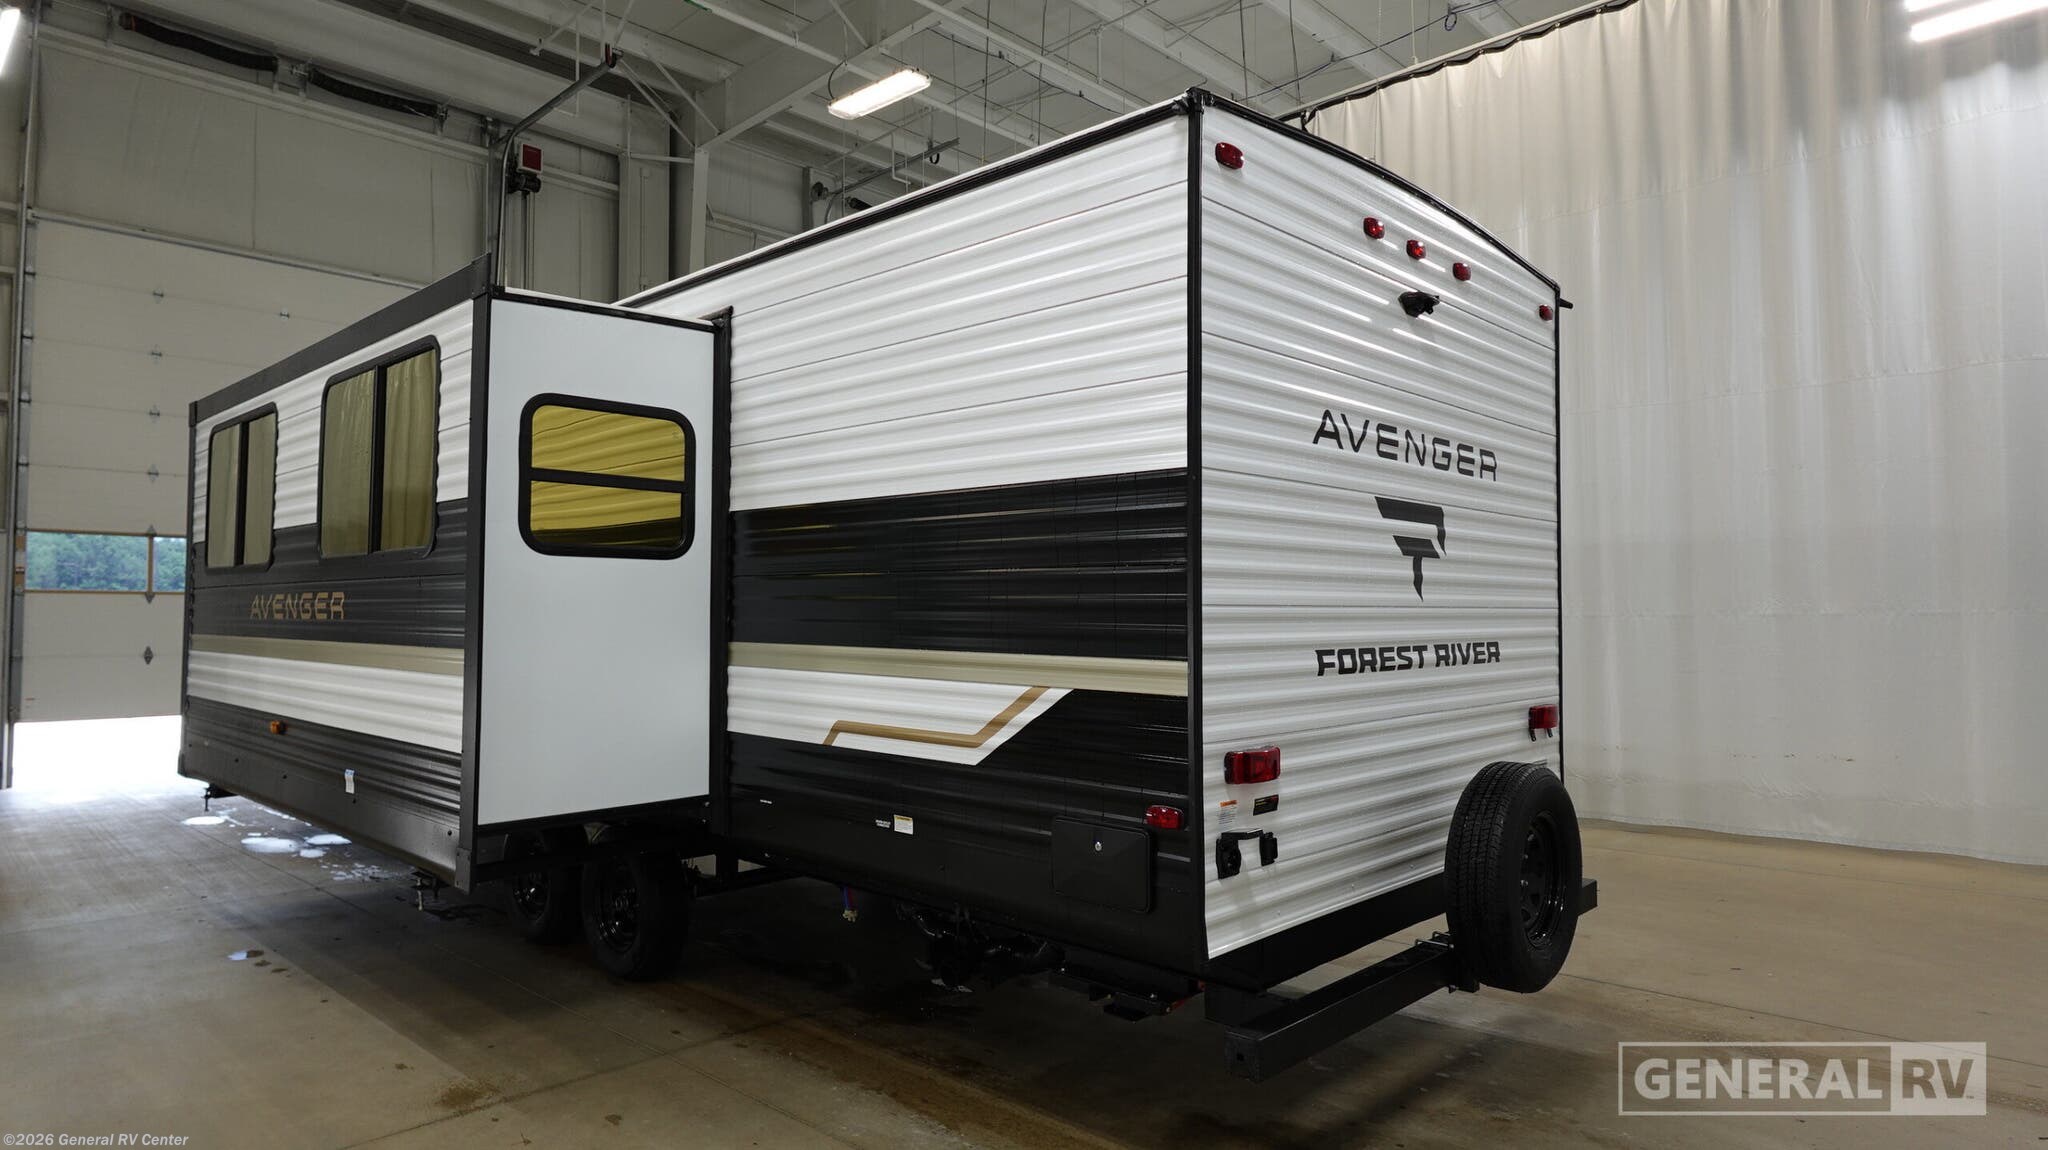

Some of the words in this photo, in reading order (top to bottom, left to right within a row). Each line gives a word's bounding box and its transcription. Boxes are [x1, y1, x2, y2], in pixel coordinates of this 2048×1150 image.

[1312, 409, 1497, 482] AVENGER
[250, 591, 345, 620] AVENGER
[1314, 645, 1428, 677] FOREST
[1434, 641, 1500, 669] RIVER
